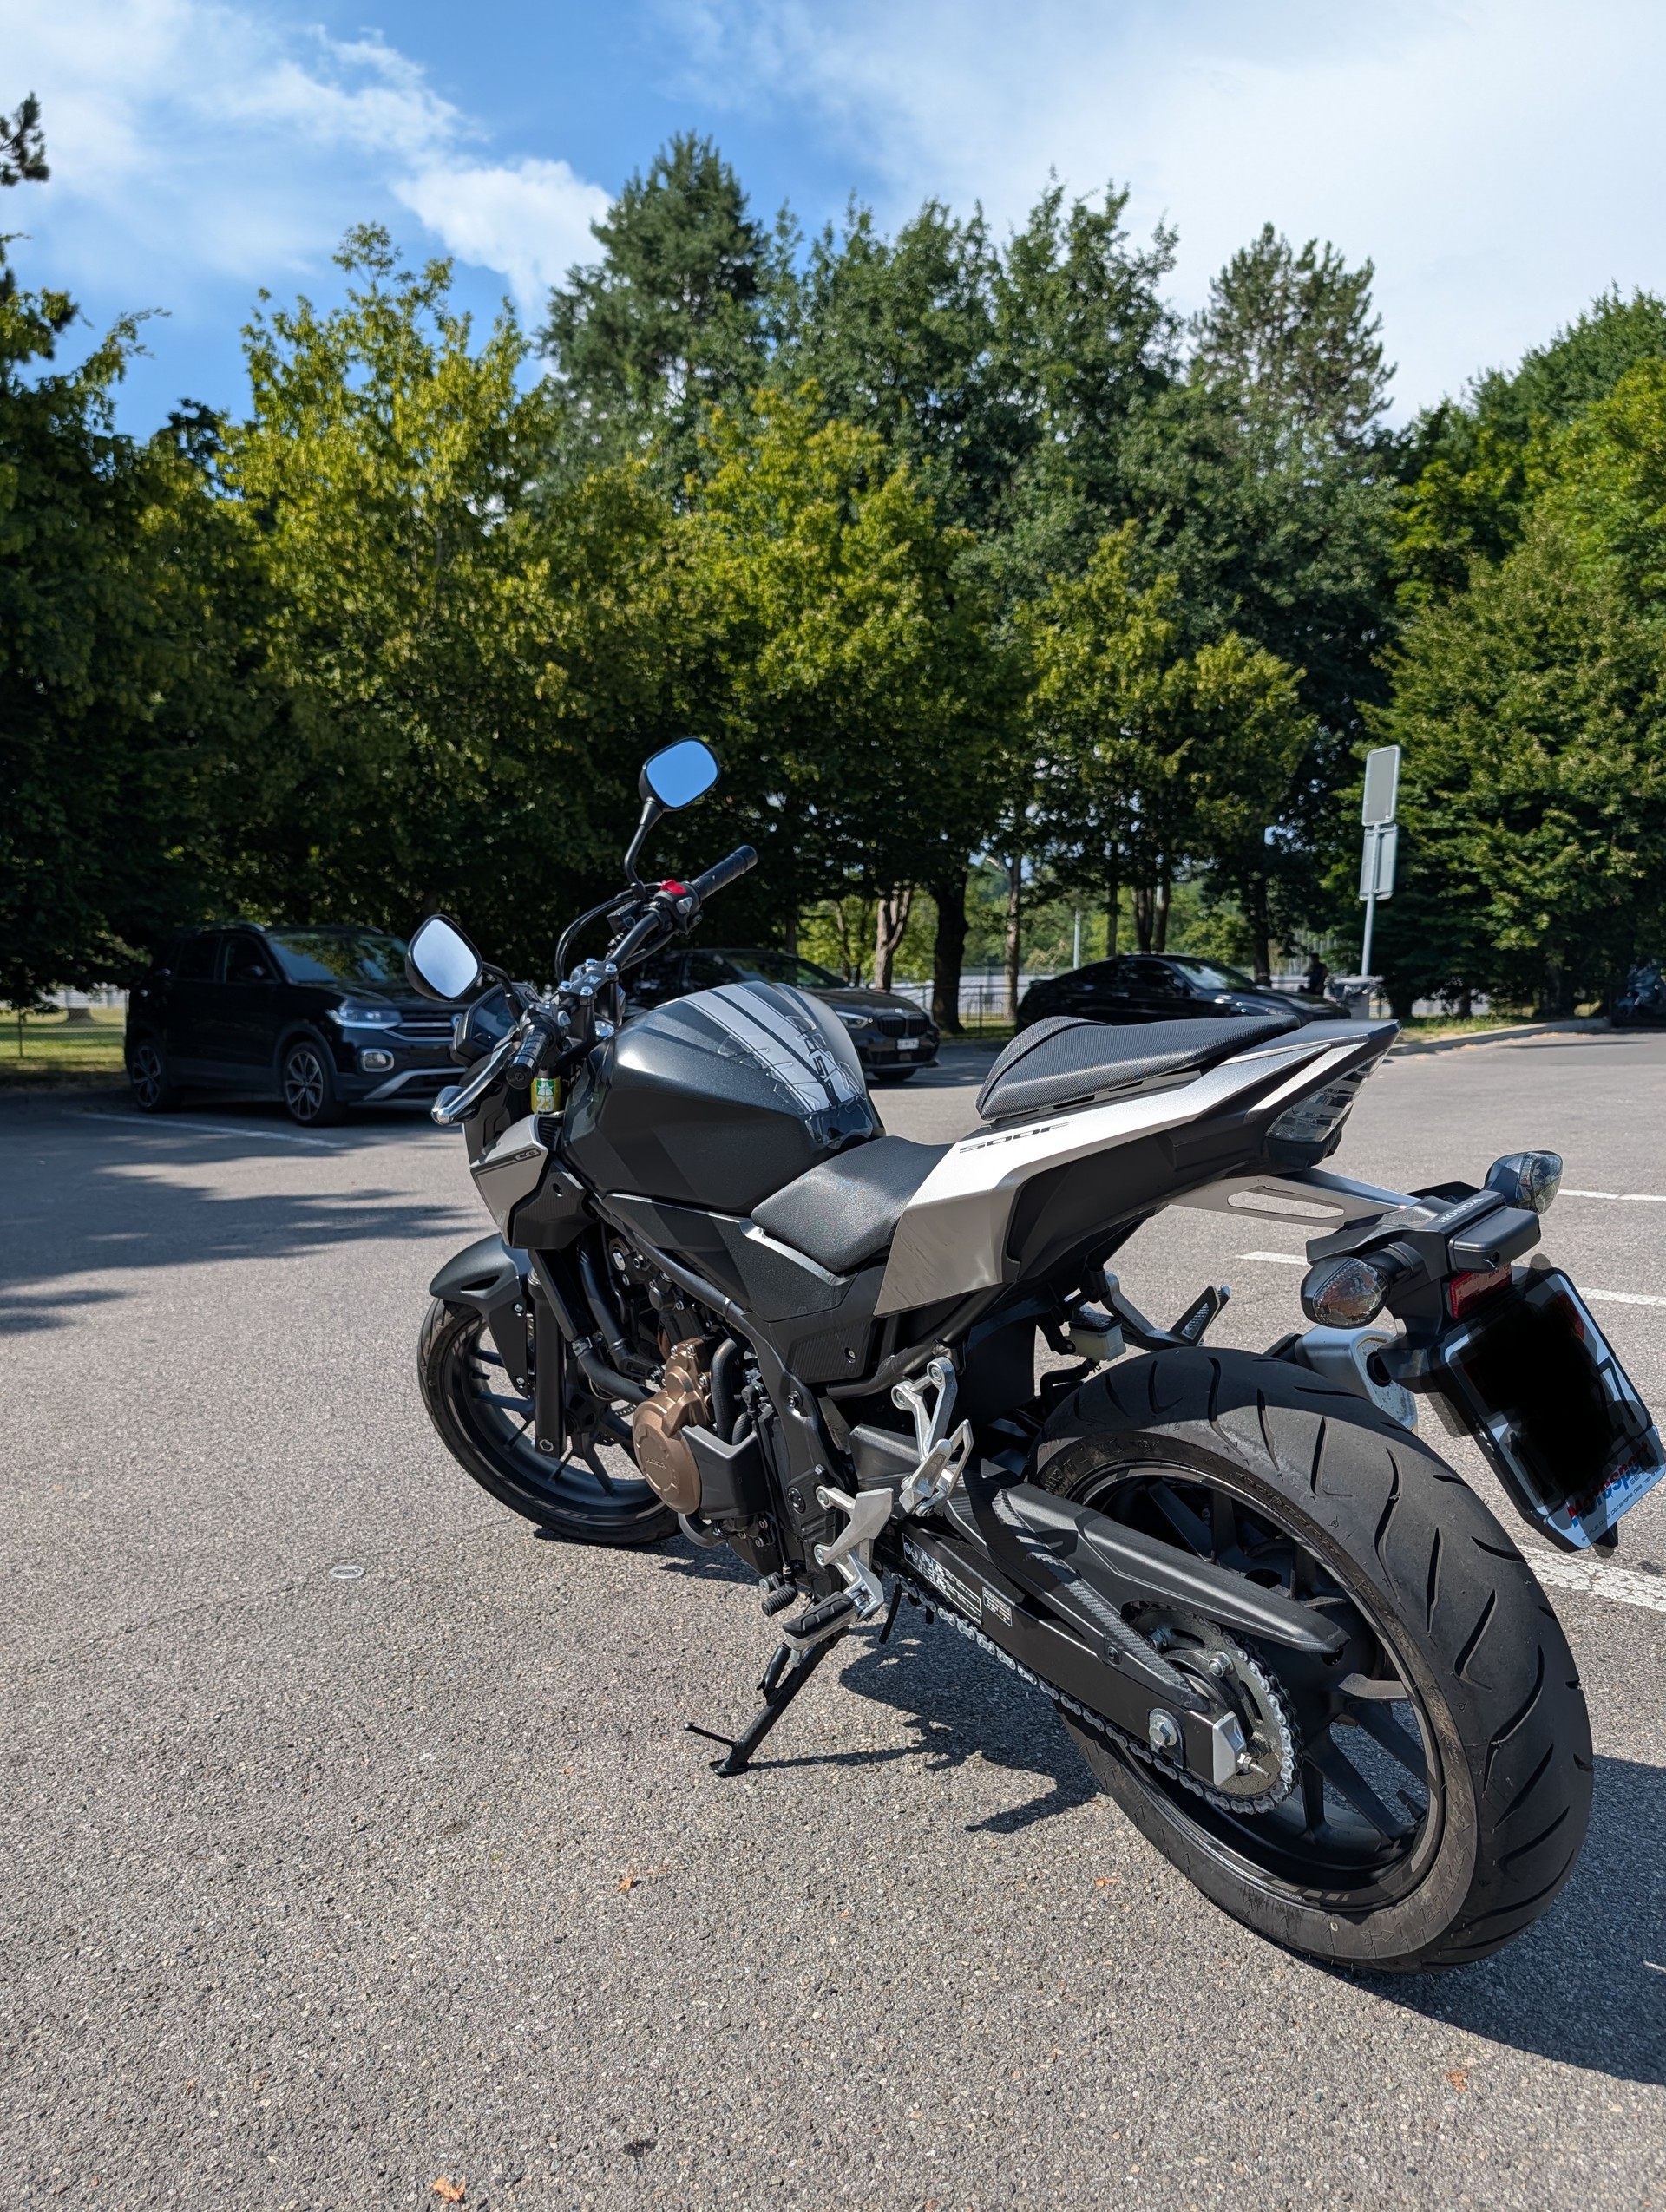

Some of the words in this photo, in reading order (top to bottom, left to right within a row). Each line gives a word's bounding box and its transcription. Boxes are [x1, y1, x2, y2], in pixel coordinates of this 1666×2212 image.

[536, 1096, 554, 1112] 23
[959, 1121, 1073, 1154] 500F
[1435, 1198, 1484, 1223] HONDA
